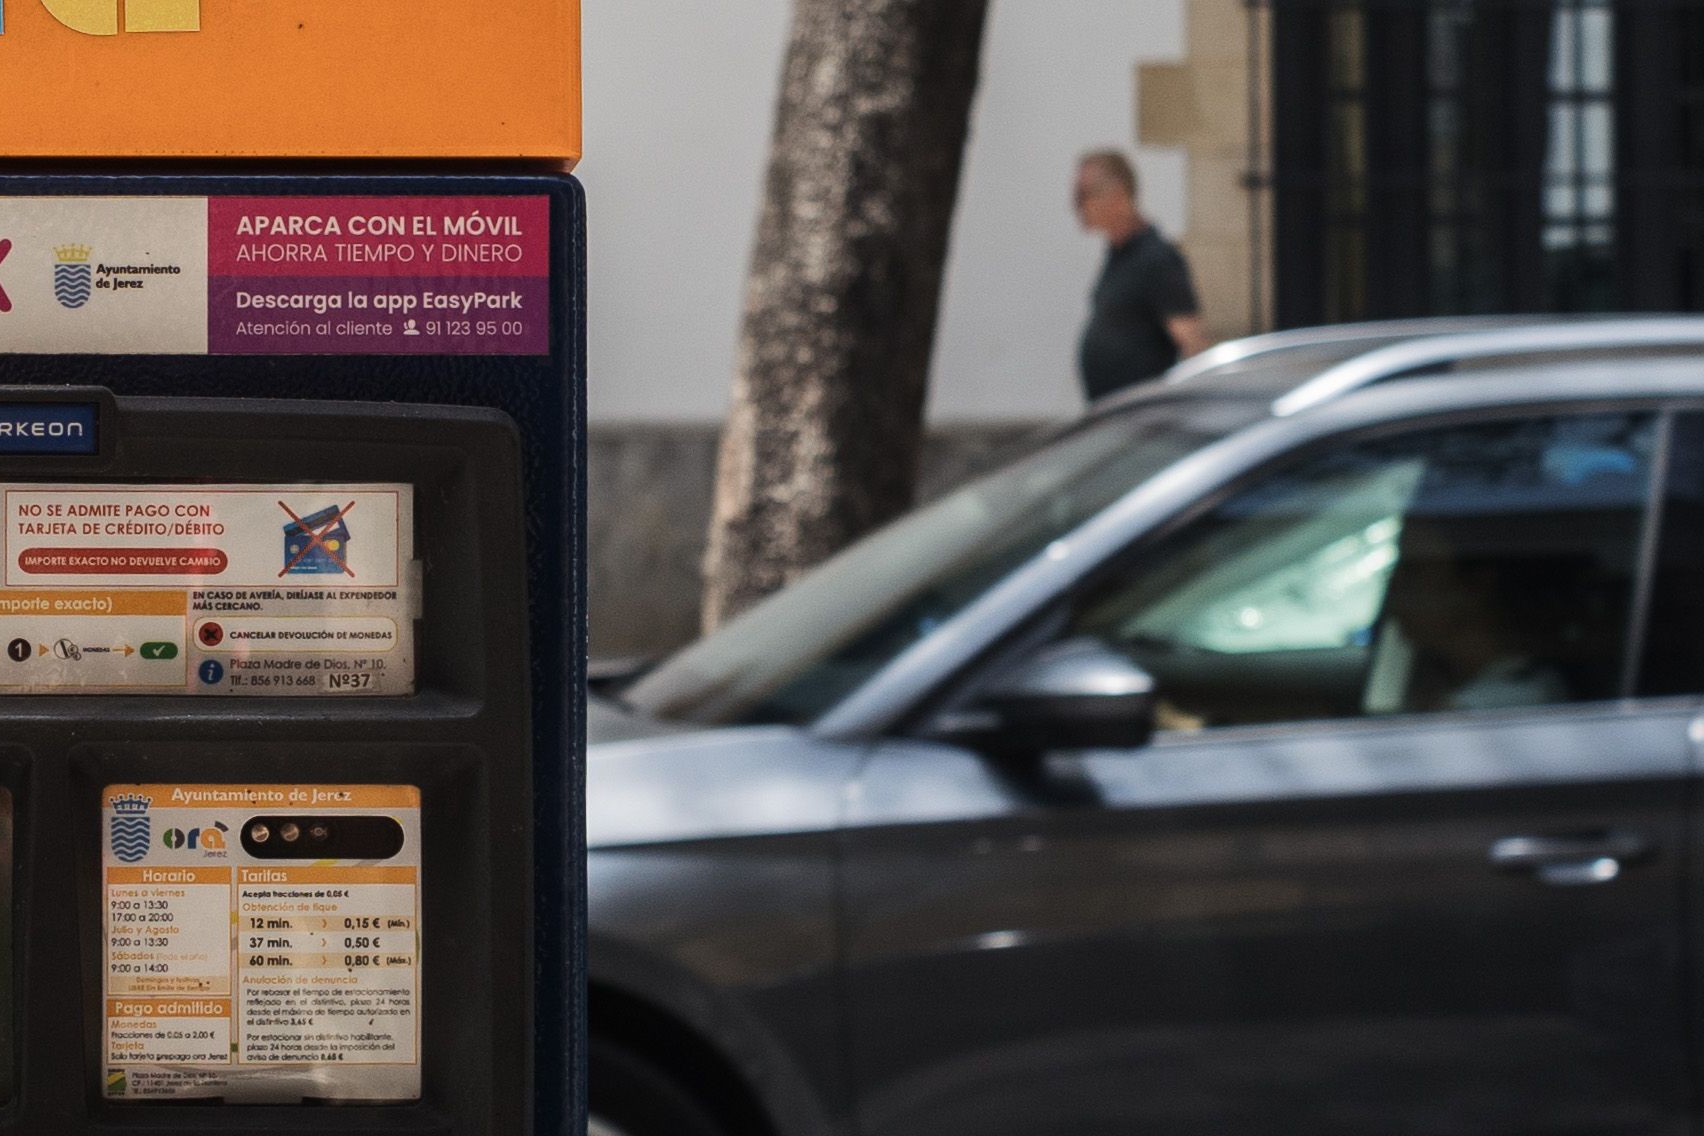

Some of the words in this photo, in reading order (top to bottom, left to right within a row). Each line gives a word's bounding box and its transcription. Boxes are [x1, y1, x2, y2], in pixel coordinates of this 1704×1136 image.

[237, 216, 341, 235] APARCA
[348, 216, 405, 235] CON
[413, 216, 437, 235] EL
[444, 210, 522, 235] MÓVIL
[236, 244, 328, 262] AHORRA
[334, 244, 415, 262] TIEMPO
[422, 244, 434, 262] Y
[442, 244, 522, 262] DINERO
[96, 264, 181, 277] Ayuntamiento
[96, 277, 110, 288] de
[112, 277, 144, 291] Jerez
[237, 291, 342, 314] Descarga
[348, 291, 367, 308] la
[373, 295, 417, 314] app
[423, 291, 523, 314] EasyPark
[236, 321, 311, 335] Atención
[316, 321, 331, 335] al
[336, 321, 393, 335] cliente
[426, 321, 441, 335] 91
[447, 321, 471, 335] 123
[476, 321, 497, 335] 95
[502, 321, 523, 335] 00
[18, 505, 42, 517] NO
[47, 505, 63, 517] SE
[67, 505, 121, 517] ADMITE
[126, 505, 170, 517] PAGO
[175, 505, 211, 517] CON
[18, 523, 77, 535] TARJETA
[82, 523, 101, 535] DE
[105, 520, 225, 536] CRÉDITO/DÉBITO
[24, 557, 67, 566] IMPORTE
[69, 557, 109, 566] EXACTO
[111, 557, 127, 566] NO
[129, 557, 177, 566] DEVUELVE
[179, 557, 222, 566] CAMBIO
[207, 592, 234, 600] CASO
[236, 592, 247, 600] DE
[54, 596, 113, 611] exacto)
[193, 601, 213, 611] MÁS
[230, 632, 276, 640] CANCELAR
[278, 630, 334, 640] DEVOLUCIÓN
[337, 632, 347, 640] DE
[349, 632, 393, 640] MONEDAS
[230, 659, 261, 670] Plaza
[264, 659, 302, 670] Madre
[305, 659, 321, 670] de
[251, 675, 272, 686] 856
[273, 675, 293, 686] 913
[295, 675, 316, 686] 668
[172, 788, 284, 804] Ayuntamiento
[288, 788, 308, 801] de
[311, 788, 352, 804] Jerez
[143, 870, 196, 882] Horario
[241, 870, 288, 882] Tarifas
[111, 889, 139, 897] Lunes
[111, 901, 131, 909] 9:00
[144, 901, 168, 909] 13:30
[112, 913, 136, 922] 17:00
[148, 913, 174, 922] 20:00
[250, 917, 264, 929] 12
[267, 917, 293, 929] min.
[372, 917, 380, 929] €
[111, 938, 131, 947] 9:00
[144, 938, 168, 947] 13:30
[249, 937, 264, 948] 37
[267, 937, 293, 948] min.
[372, 937, 380, 948] €
[249, 955, 264, 966] 60
[267, 955, 293, 966] min.
[372, 955, 380, 966] €
[111, 964, 131, 973] 9:00
[144, 964, 169, 973] 14:00
[115, 1001, 153, 1016] Pago
[157, 1001, 223, 1014] admitido
